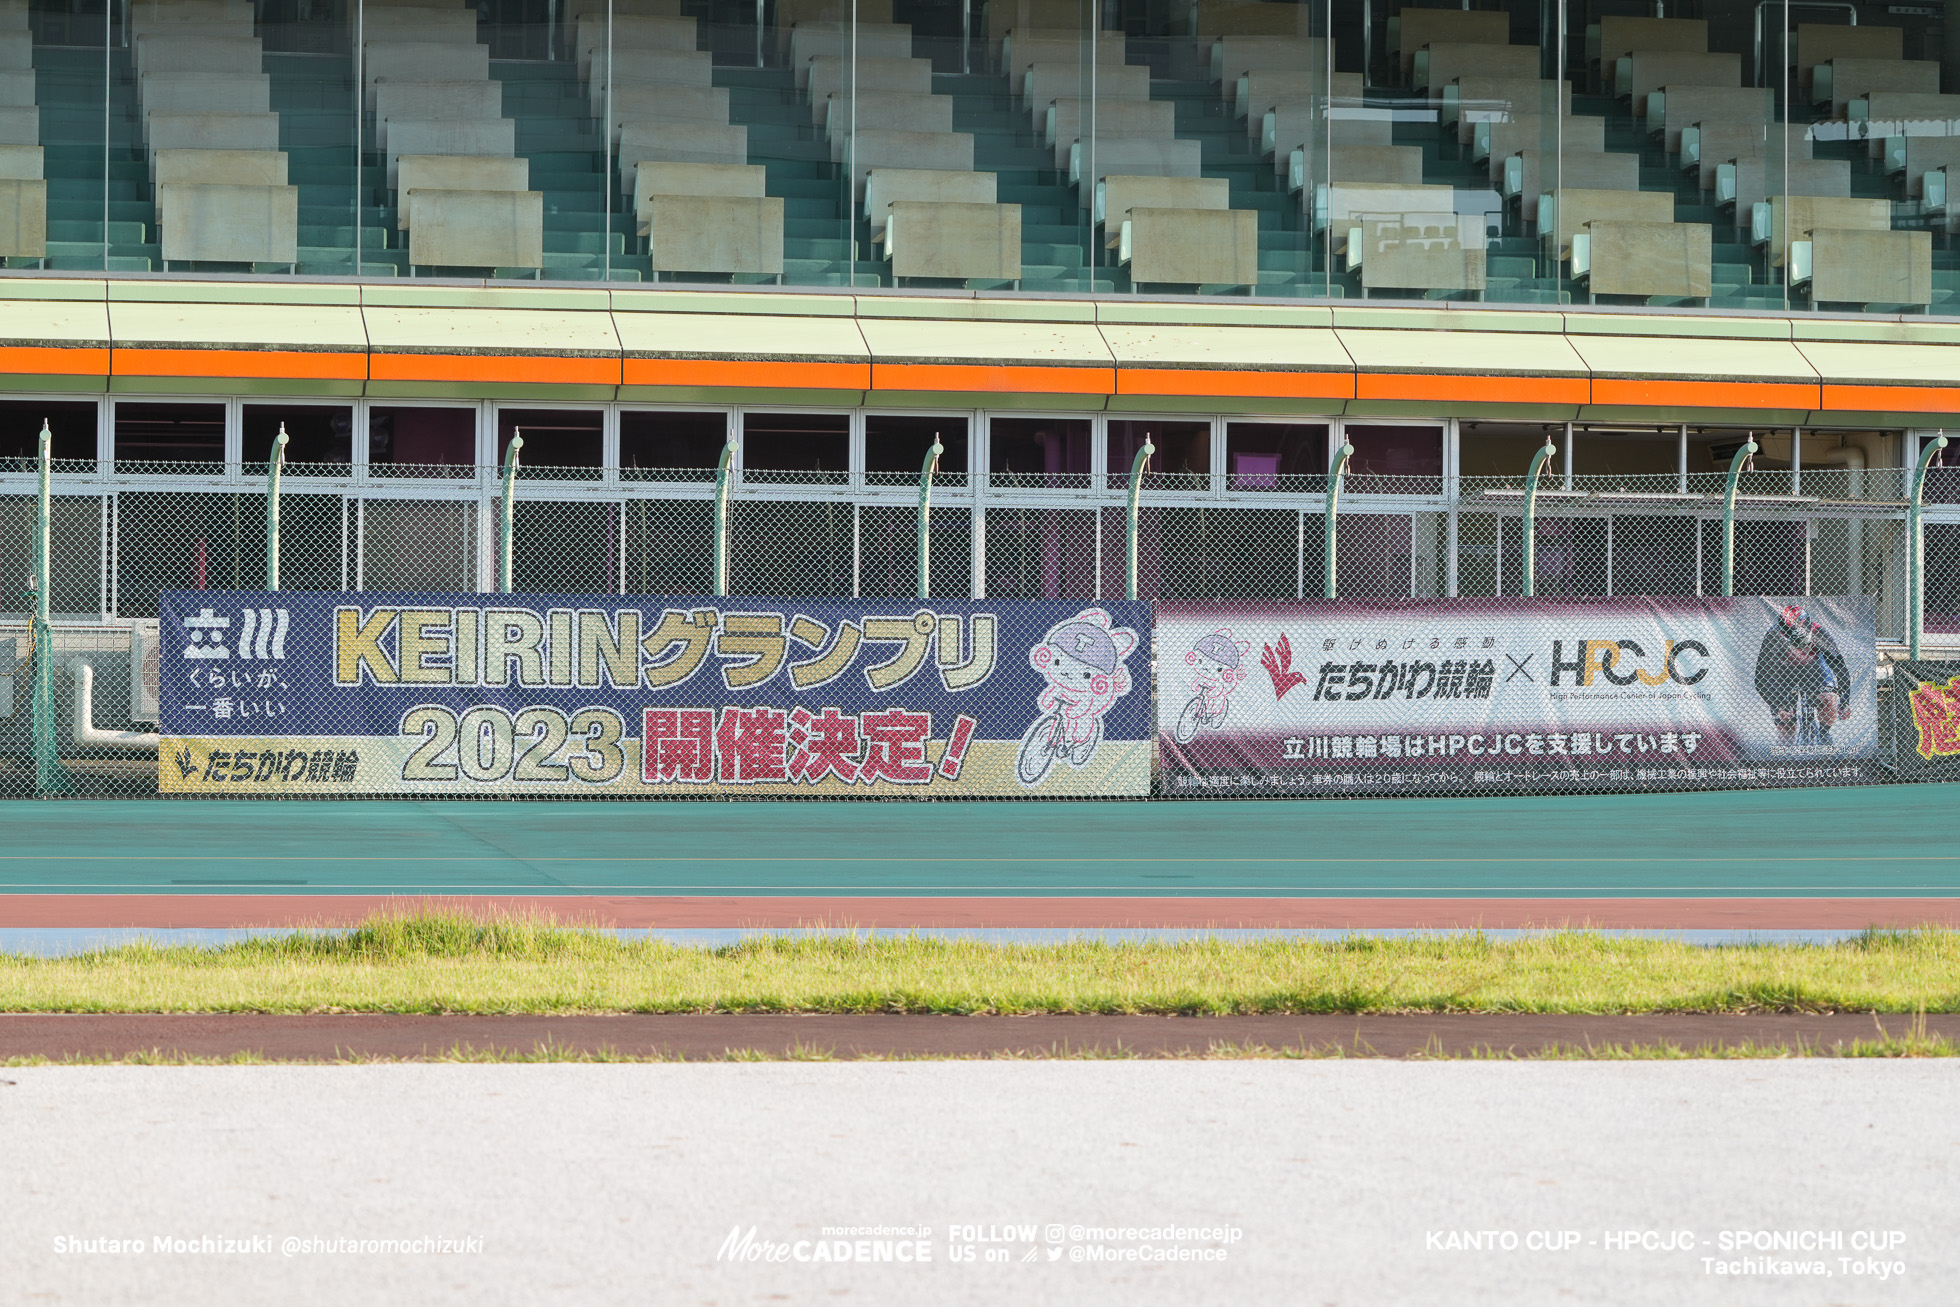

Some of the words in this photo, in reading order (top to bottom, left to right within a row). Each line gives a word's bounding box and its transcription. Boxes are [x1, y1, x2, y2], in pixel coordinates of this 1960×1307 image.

[333, 605, 998, 692] KEIRINグランプリ
[190, 667, 289, 691] くらいが、
[1313, 658, 1497, 702] たちかわ競輪
[1550, 639, 1711, 687] HPCJC
[185, 697, 287, 720] 一番いい
[1550, 692, 1568, 702] High
[1570, 691, 1619, 701] Performance
[1657, 691, 1682, 701] Japan
[1683, 690, 1712, 702] Cycling
[401, 703, 626, 784] 2023
[1282, 731, 1702, 760] 立川競輪場はHPCJCを支援しています
[203, 748, 360, 784] たちかわ競輪
